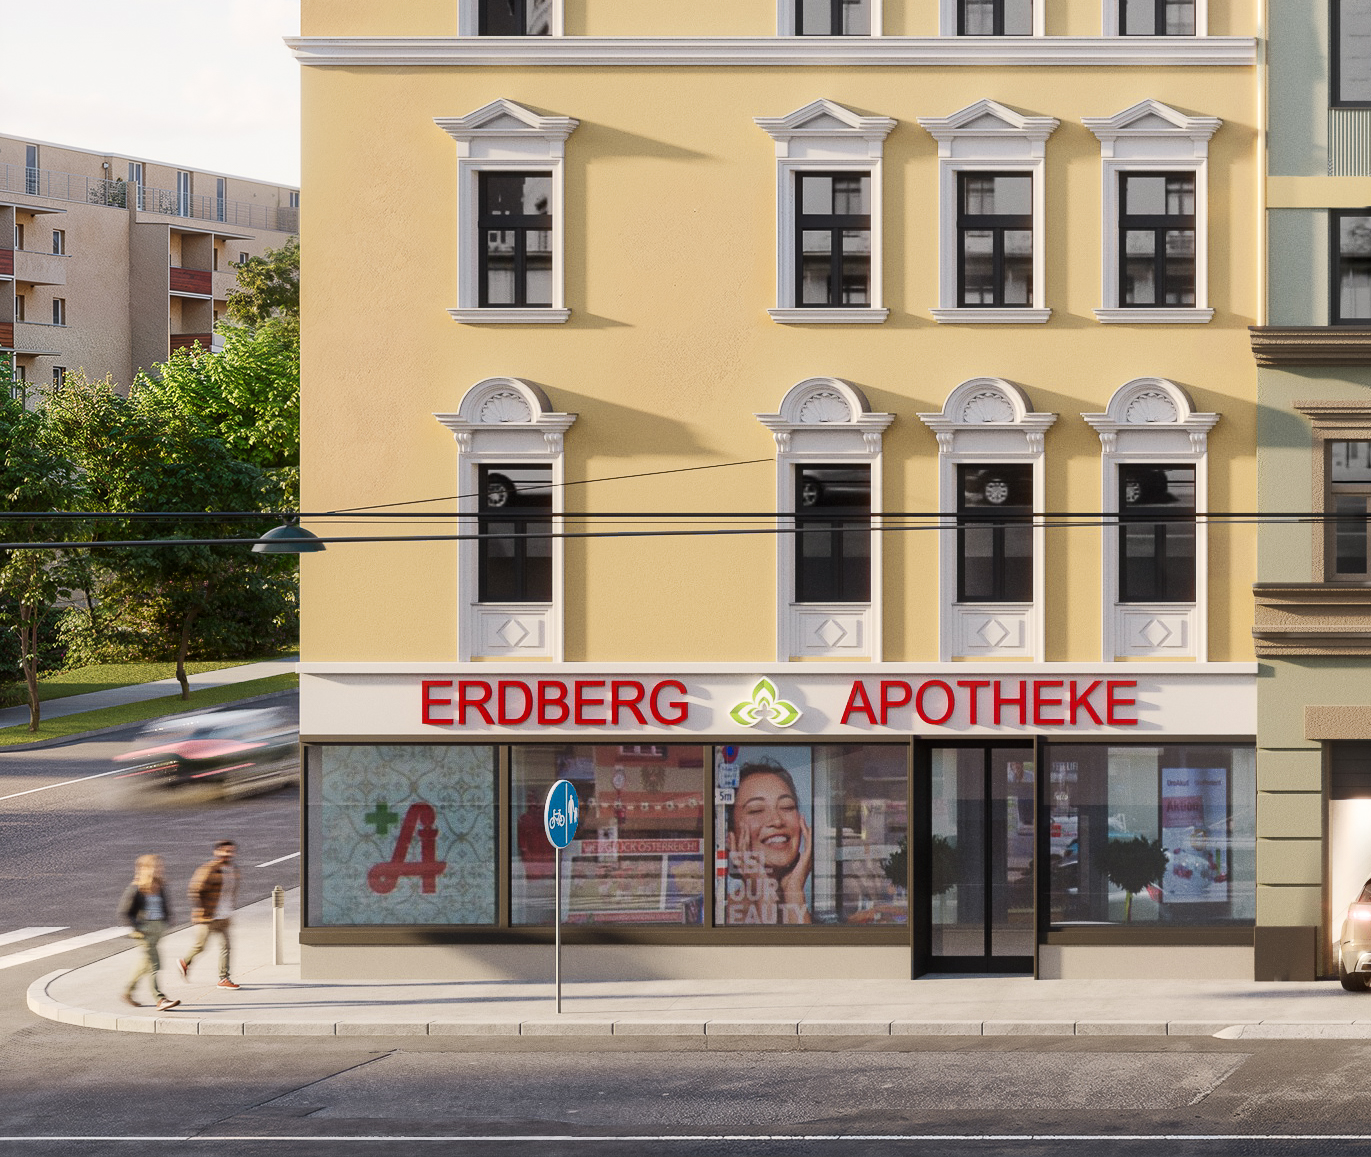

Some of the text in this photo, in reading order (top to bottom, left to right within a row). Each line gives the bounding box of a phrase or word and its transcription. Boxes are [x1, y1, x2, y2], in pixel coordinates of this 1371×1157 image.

[421, 679, 1139, 726] ERDBERG APOTHEKE
[728, 877, 780, 902] OUR
[728, 903, 808, 925] EAUTY
